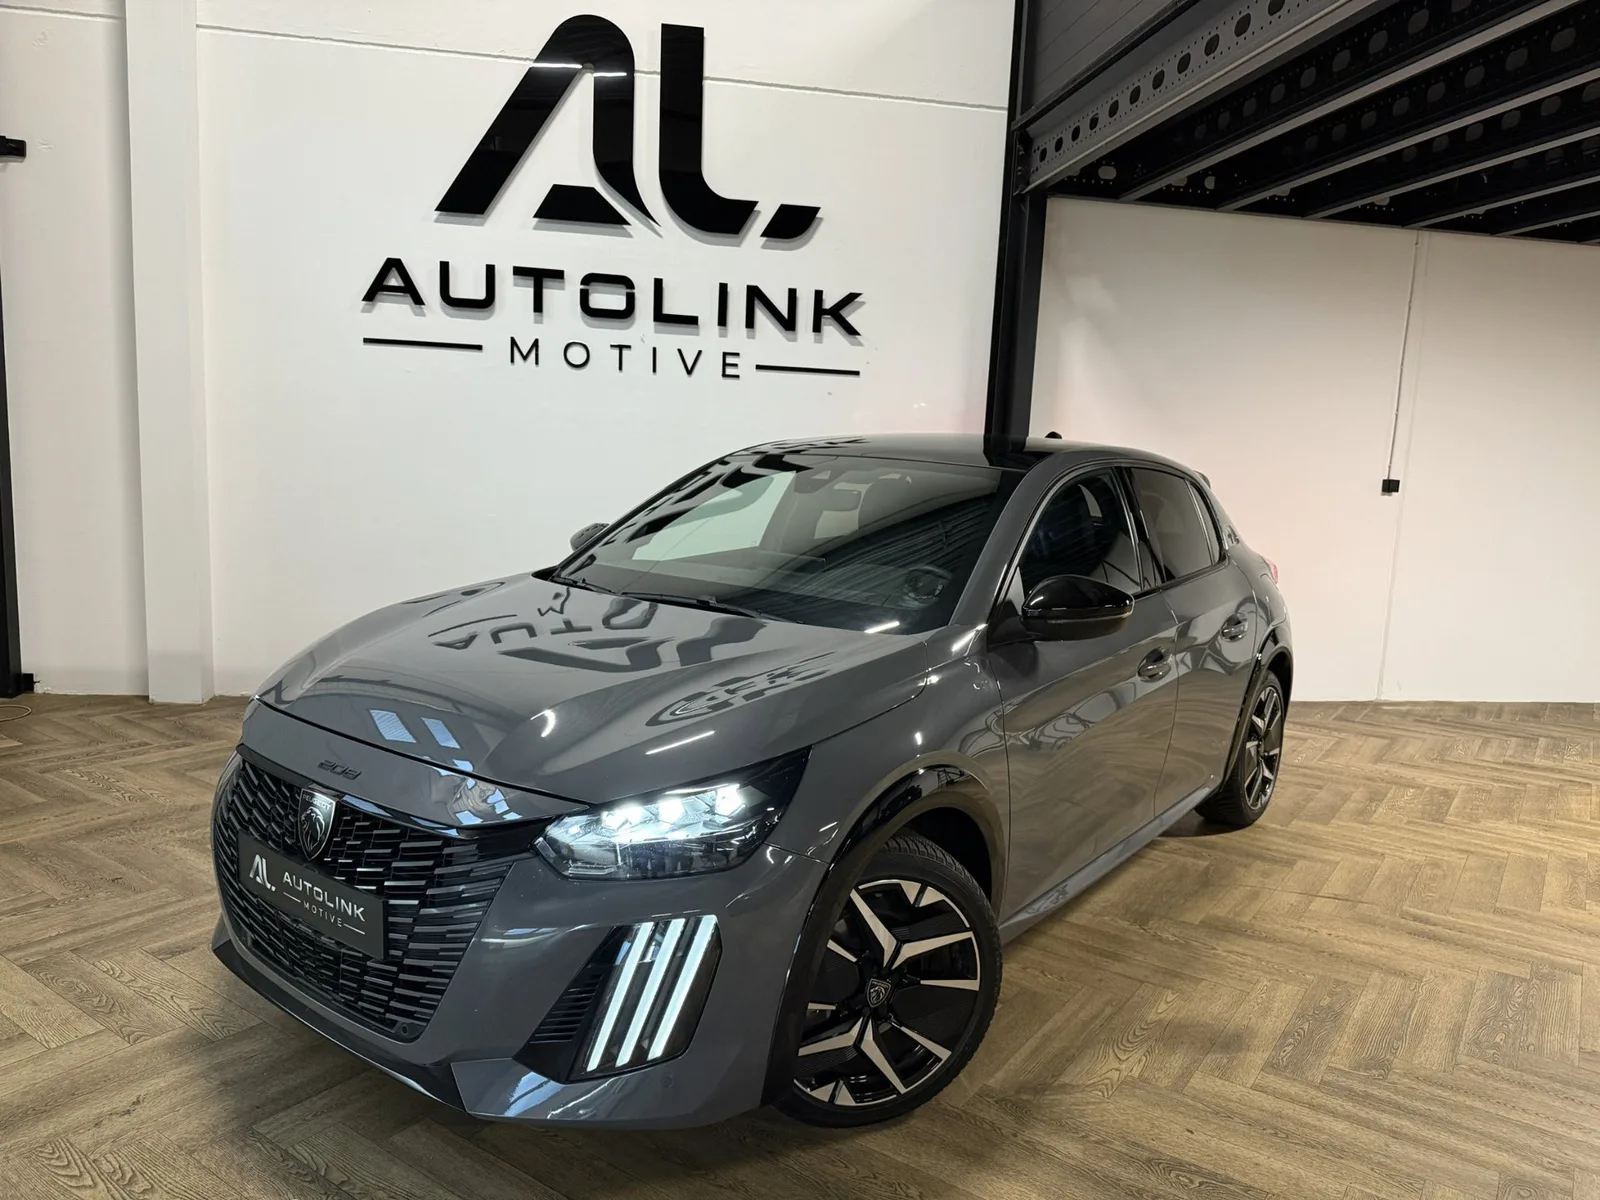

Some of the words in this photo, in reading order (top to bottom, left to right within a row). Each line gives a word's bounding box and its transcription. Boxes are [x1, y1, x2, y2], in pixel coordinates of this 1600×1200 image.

[361, 257, 864, 337] AUTOLINK
[510, 336, 741, 379] MOTIVE
[318, 759, 362, 780] 208
[282, 871, 366, 922] AUTOLINK
[303, 901, 342, 927] MOTIVE
